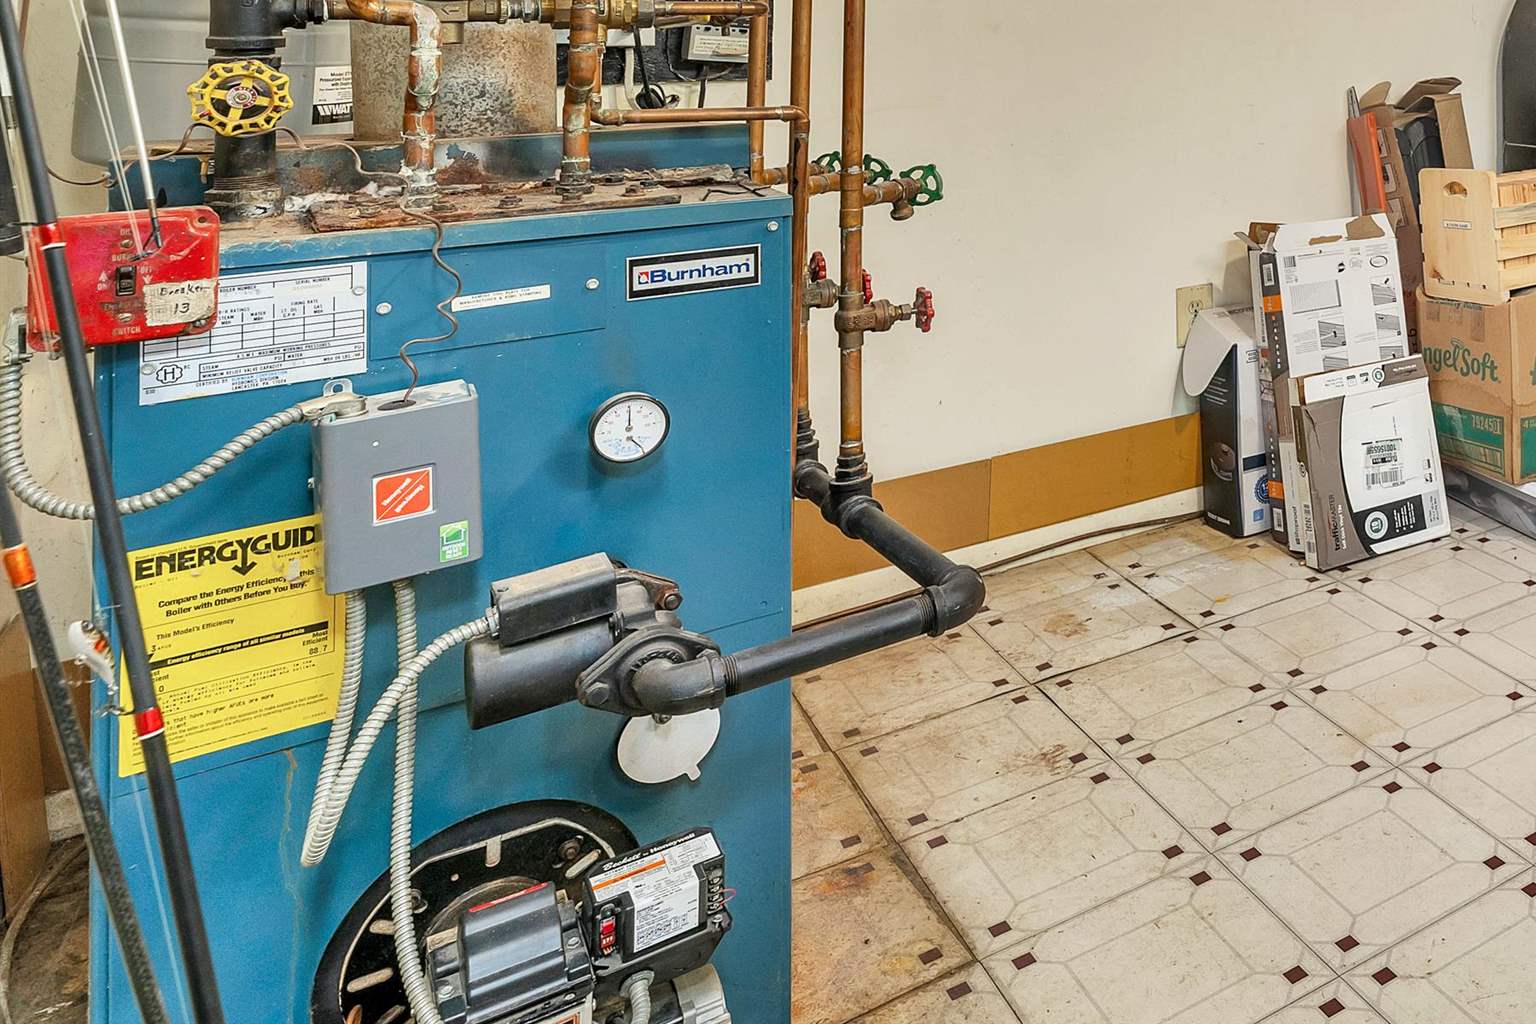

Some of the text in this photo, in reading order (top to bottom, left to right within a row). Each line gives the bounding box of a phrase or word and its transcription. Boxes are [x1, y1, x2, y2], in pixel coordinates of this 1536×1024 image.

[650, 260, 751, 284] Burnham
[159, 284, 208, 297] Breaker
[173, 302, 190, 315] 13
[112, 326, 140, 335] SWITCH
[1424, 341, 1500, 382] ngel Soft
[135, 526, 317, 581] ENERGYGUID
[158, 567, 315, 609] Compare the Energy Efficiency this
[166, 579, 308, 618] Boiler with Others Before You Buy.
[157, 617, 235, 641] This Model's Efficiency
[302, 635, 328, 647] Efficient
[312, 629, 328, 639] Most
[602, 852, 641, 871] Beckett
[650, 832, 696, 853] Honeywell
